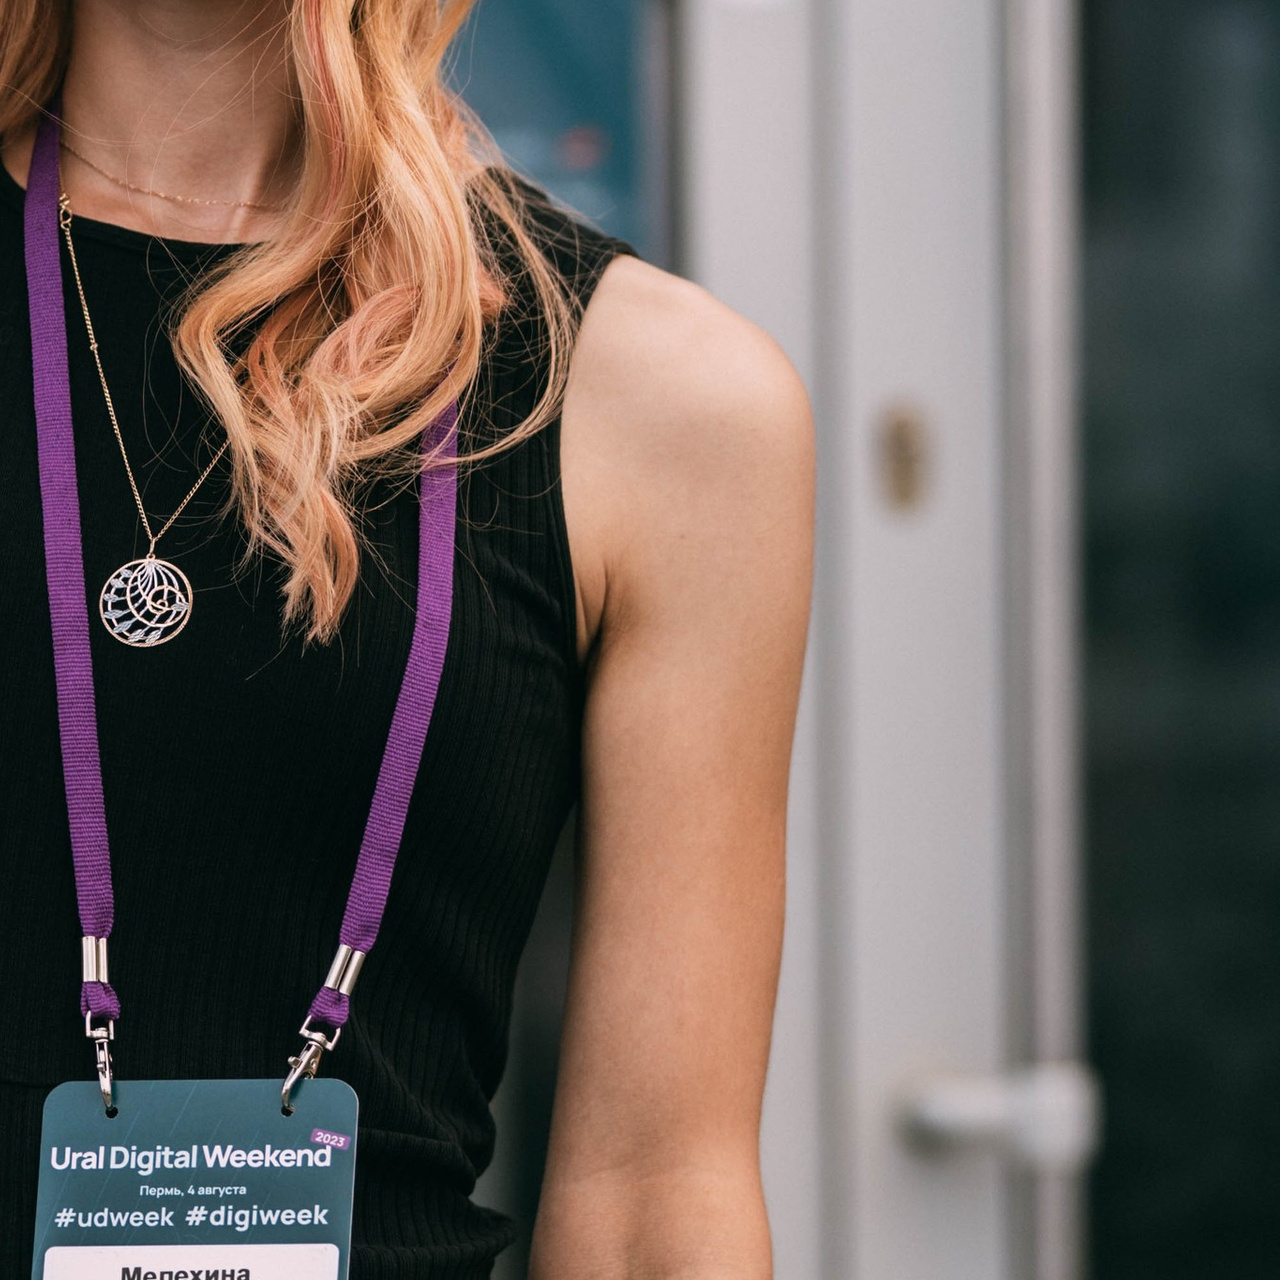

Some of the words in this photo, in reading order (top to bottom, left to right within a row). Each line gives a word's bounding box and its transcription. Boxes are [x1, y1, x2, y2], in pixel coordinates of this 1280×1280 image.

[315, 1132, 345, 1147] 2023
[51, 1145, 105, 1170] Ural
[109, 1145, 198, 1176] Digital
[202, 1144, 332, 1168] Weekend
[139, 1185, 184, 1198] Пермь,
[187, 1185, 195, 1195] 4
[198, 1185, 247, 1197] августа
[54, 1207, 174, 1227] #udweek
[185, 1204, 329, 1232] #digiweek
